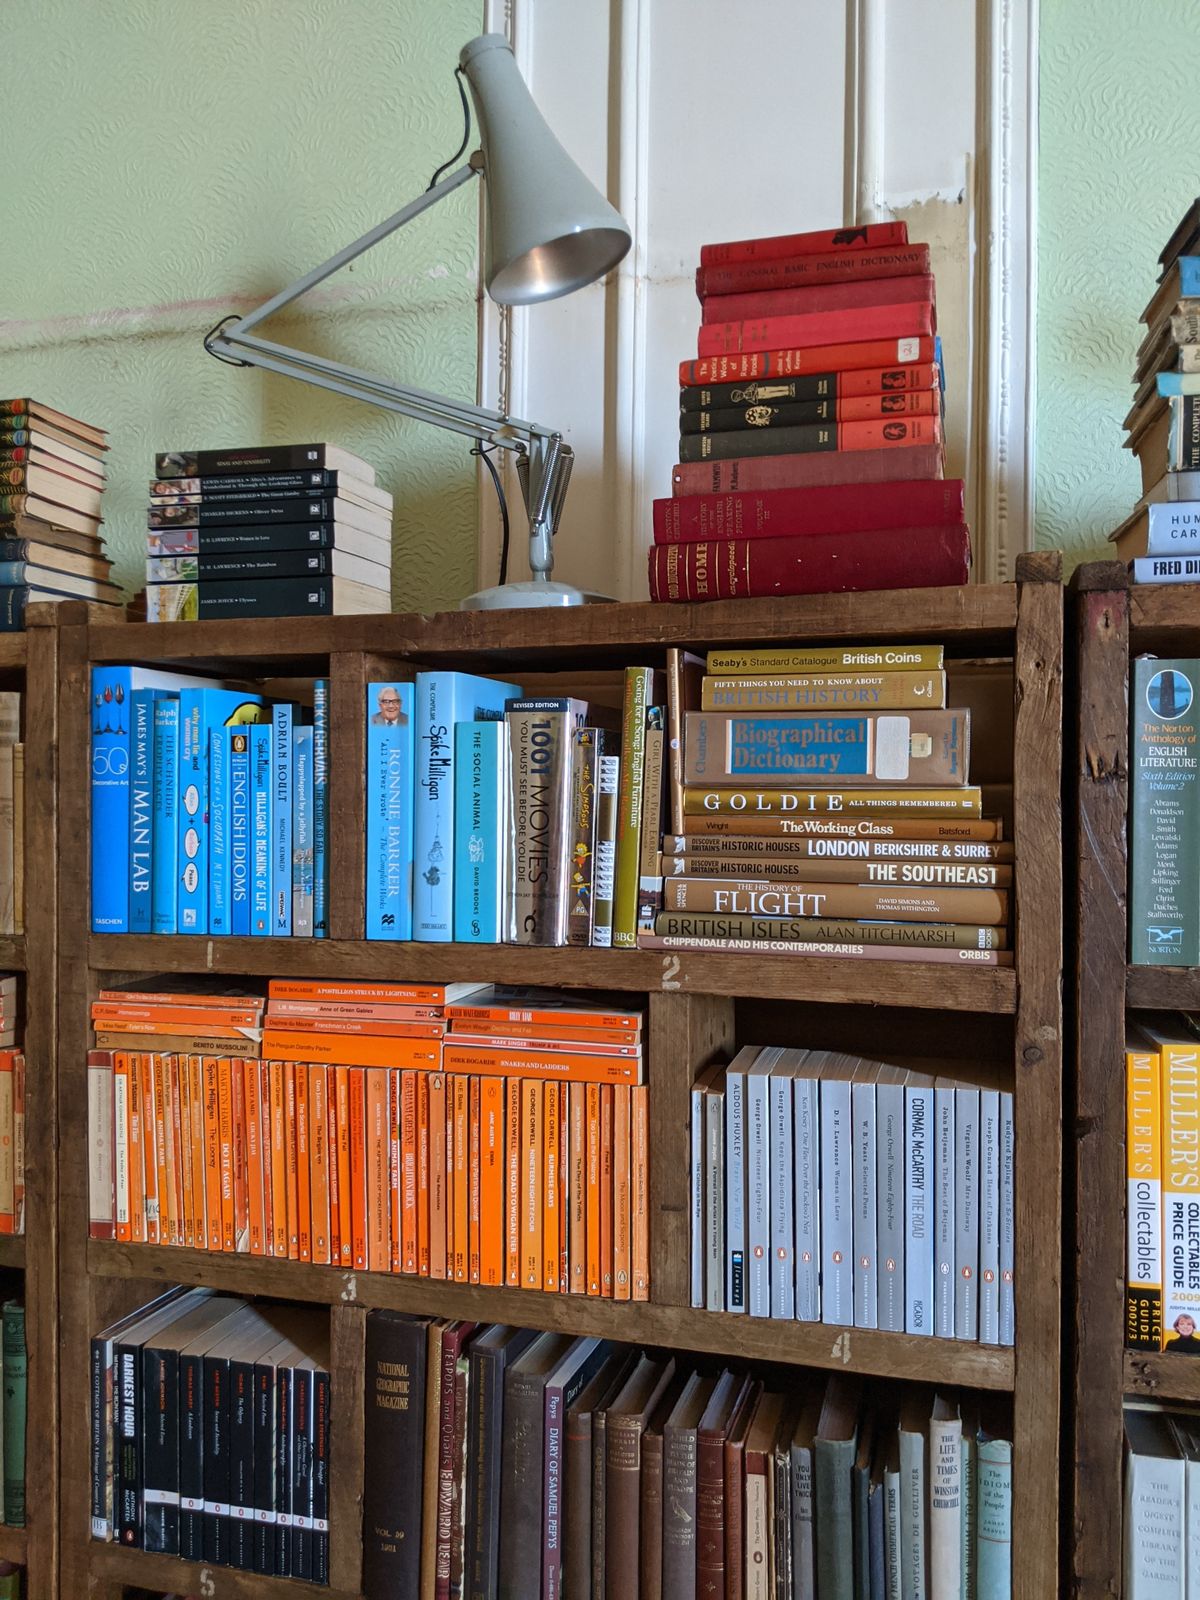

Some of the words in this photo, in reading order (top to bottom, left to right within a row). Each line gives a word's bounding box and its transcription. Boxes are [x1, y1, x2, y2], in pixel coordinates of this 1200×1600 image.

[817, 260, 854, 271] ENGLISH
[861, 254, 920, 266] DICTIONARY
[1154, 561, 1182, 575] FRED
[712, 657, 747, 668] Seaby's
[750, 657, 790, 666] Standard
[792, 656, 837, 666] Catalogue
[842, 653, 883, 665] British
[885, 652, 922, 664] Coins
[635, 676, 644, 703] Going
[713, 690, 788, 705] BRITISH
[796, 688, 883, 704] HISTORY
[738, 680, 768, 688] THINGS
[314, 689, 327, 726] RICKY
[136, 704, 146, 738] JAMES
[520, 720, 528, 743] YOU
[734, 719, 865, 746] Biographical
[1144, 724, 1158, 732] The
[1160, 724, 1194, 733] Norton
[278, 712, 287, 758] ADRIAN
[422, 725, 447, 756] Spike
[531, 720, 551, 774] 1001
[1141, 735, 1186, 744] Anthology
[1188, 735, 1197, 743] of
[192, 757, 200, 770] and
[213, 733, 222, 784] CONFESSIONS
[519, 746, 528, 776] MUST
[734, 749, 841, 772] Dictionary
[1140, 758, 1197, 767] LITERATURE
[1149, 747, 1187, 756] ENGLISH
[422, 758, 451, 800] Milligan
[473, 755, 481, 788] SOCIAL
[631, 752, 642, 783] English
[651, 765, 660, 790] WITH
[1165, 772, 1195, 781] Edition
[278, 764, 287, 802] BOULT
[389, 750, 400, 819] RONNIE
[519, 779, 527, 797] SEE
[233, 772, 246, 838] ENGLISH
[315, 804, 323, 826] STORY
[472, 791, 480, 830] ANIMAL
[631, 786, 640, 828] Furniture
[704, 794, 843, 810] GOLDIE
[899, 800, 957, 808] REMEMBERED
[134, 790, 150, 844] MAN
[213, 802, 224, 854] SOCIOPATH
[518, 799, 527, 836] BEFORE
[858, 822, 894, 835] Class
[1156, 825, 1176, 833] Smith
[528, 785, 549, 883] MOVIES
[256, 840, 266, 878] MEANING
[388, 826, 400, 897] BARKER
[518, 840, 526, 863] YOU
[721, 841, 763, 851] HISTORIC
[764, 842, 800, 852] HOUSES
[808, 840, 869, 857] LONDON
[874, 844, 940, 857] BERKSHIRE
[954, 845, 1000, 858] SURREY
[134, 852, 149, 892] LAB
[234, 842, 246, 900] IDIOMS
[518, 866, 526, 882] DIE
[867, 865, 897, 882] THE
[902, 866, 997, 884] SOUTHEAST
[256, 892, 266, 911] LIFE
[713, 891, 826, 917] FLIGHT
[614, 932, 634, 942] BBC
[668, 919, 743, 937] BRITISH
[752, 922, 801, 938] ISLES
[816, 927, 855, 938] ALAN
[859, 928, 956, 942] TITCHMARSH
[663, 937, 726, 949] CHIPPENDALE
[727, 939, 751, 949] AND
[753, 940, 770, 950] HIS
[771, 942, 864, 954] CONTEMPORARIES
[959, 951, 990, 960] ORBIS
[1149, 946, 1181, 954] NORTON
[662, 955, 680, 980] 2
[193, 1042, 214, 1050] BENITO
[216, 1043, 248, 1052] MUSSOLINI
[733, 1084, 741, 1119] ALDOUS
[912, 1098, 924, 1138] CORMAC
[1170, 1052, 1198, 1187] MILLER'S
[223, 1143, 229, 1157] DO
[733, 1122, 741, 1157] HUXLEY
[964, 1124, 972, 1157] Virginia
[223, 1160, 229, 1169] IT
[912, 1140, 924, 1190] McCARTHY
[1004, 1156, 1012, 1185] Kipling
[912, 1194, 924, 1211] THE
[912, 1214, 924, 1238] ROAD
[1137, 1182, 1156, 1279] collectables
[1172, 1202, 1183, 1241] PRICE
[1172, 1244, 1184, 1288] GUIDE
[913, 1300, 922, 1327] PICADOR
[1128, 1299, 1137, 1339] 2002/3
[1152, 1301, 1160, 1342] PRICE
[123, 1354, 134, 1404] DARKEST
[377, 1361, 409, 1376] NATIONAL
[376, 1380, 410, 1394] GEOGRAPHIC
[376, 1396, 409, 1410] MAGAZINE
[444, 1400, 452, 1420] and
[549, 1396, 559, 1418] Pepys
[124, 1406, 135, 1437] HOUR
[441, 1424, 453, 1465] Quails
[549, 1428, 558, 1459] DIARY
[939, 1445, 956, 1454] LIFE
[549, 1460, 558, 1475] OF
[937, 1466, 958, 1475] TIMES
[438, 1469, 453, 1538] EDWARD
[548, 1476, 558, 1516] SAMUEL
[888, 1488, 896, 1512] TERMS
[933, 1499, 959, 1509] CHURCHILL
[934, 1486, 960, 1496] WINSTON
[548, 1519, 557, 1549] PEPYS
[889, 1515, 897, 1562] COMMERCIAL
[913, 1524, 919, 1536] DE
[437, 1543, 451, 1579] LEAR
